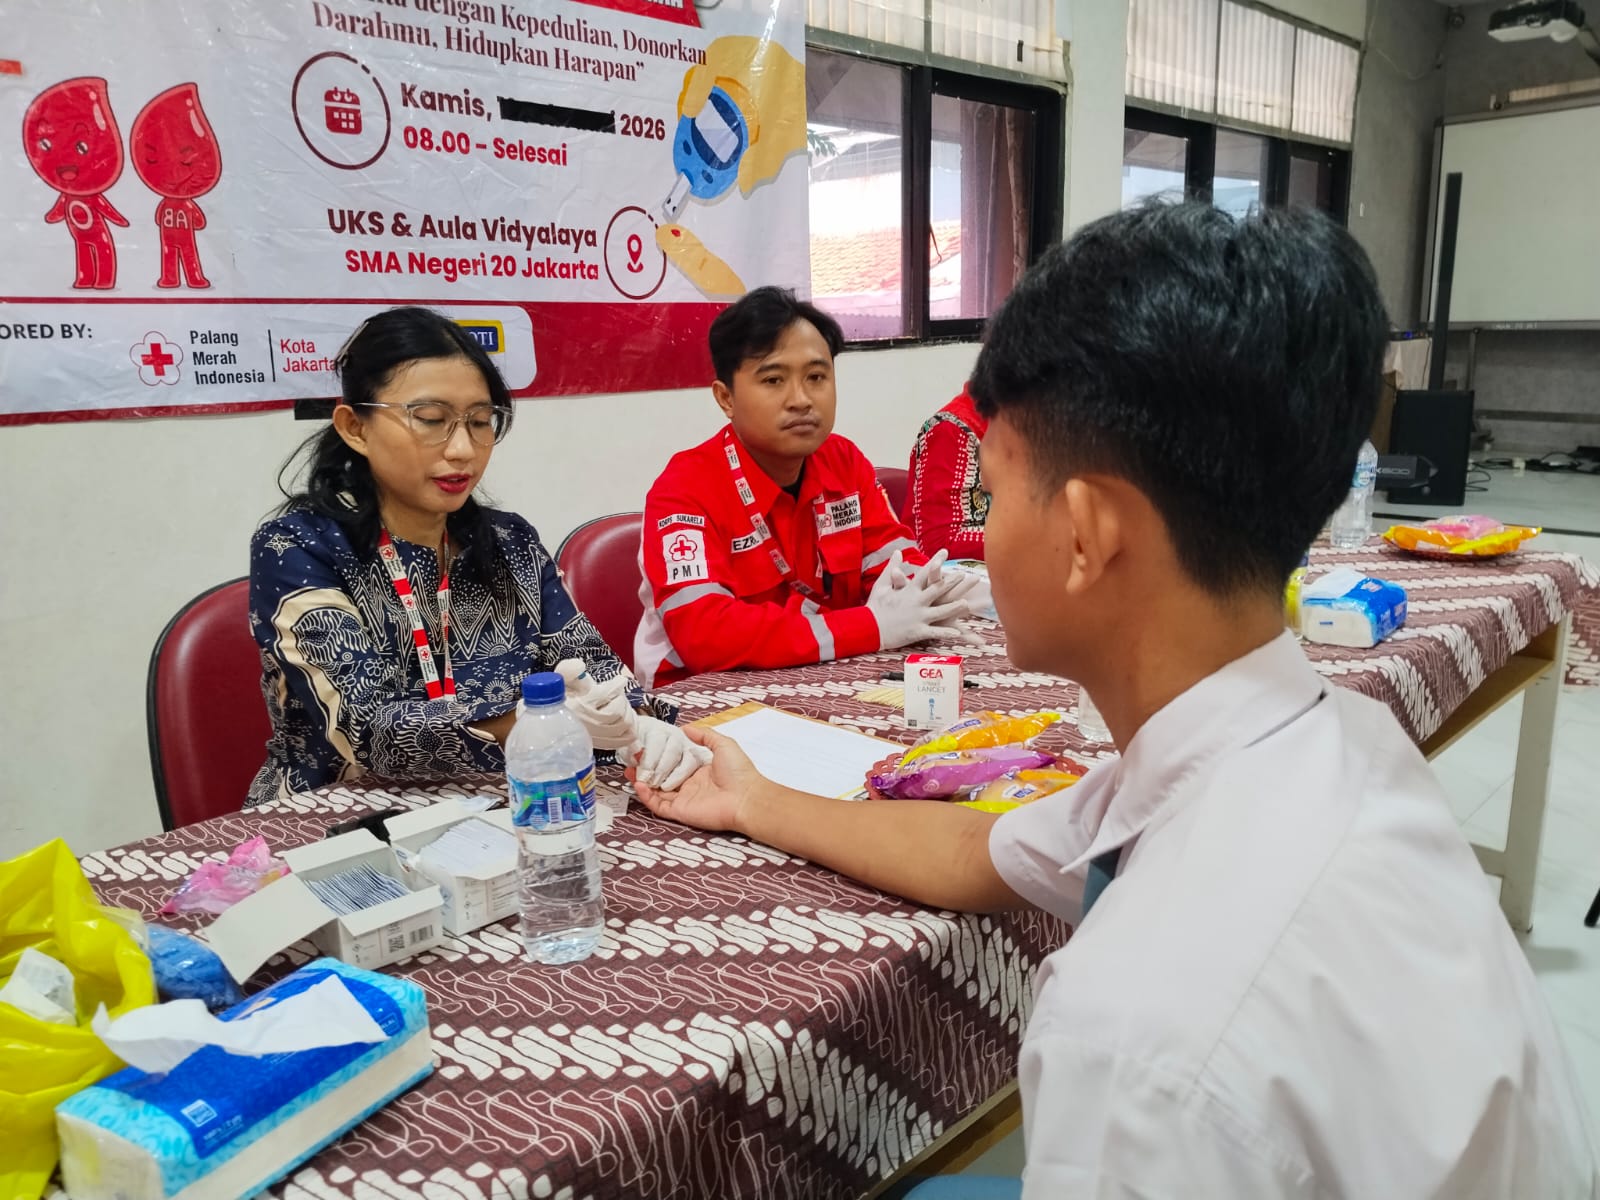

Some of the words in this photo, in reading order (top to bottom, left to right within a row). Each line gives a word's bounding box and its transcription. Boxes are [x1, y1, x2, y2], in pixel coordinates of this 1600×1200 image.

[313, 1, 438, 49] Darahmu,
[444, 26, 549, 66] Hidupkan
[501, 4, 619, 49] Kepedulian,
[623, 28, 708, 65] Donorkan
[400, 82, 493, 122] Kamis,
[620, 116, 666, 141] 2026
[403, 126, 471, 155] 08.00
[493, 137, 568, 166] Selesai
[327, 208, 385, 236] UKS
[390, 211, 414, 237] &
[418, 214, 478, 242] Aula
[481, 216, 598, 254] Vidyalaya
[346, 249, 401, 273] SMA
[408, 251, 487, 282] Negeri
[490, 254, 517, 277] 20
[521, 257, 599, 280] Jakarta
[60, 323, 93, 340] BY:
[189, 330, 239, 346] Palang
[280, 338, 316, 354] Kota
[192, 351, 237, 366] Merah
[282, 356, 337, 373] Jakarta
[194, 369, 265, 385] Indonesia
[830, 500, 858, 513] PALANG
[832, 507, 858, 520] MERAH
[676, 514, 703, 525] SUKARELA
[834, 514, 862, 528] INDONE
[919, 667, 944, 679] GEA
